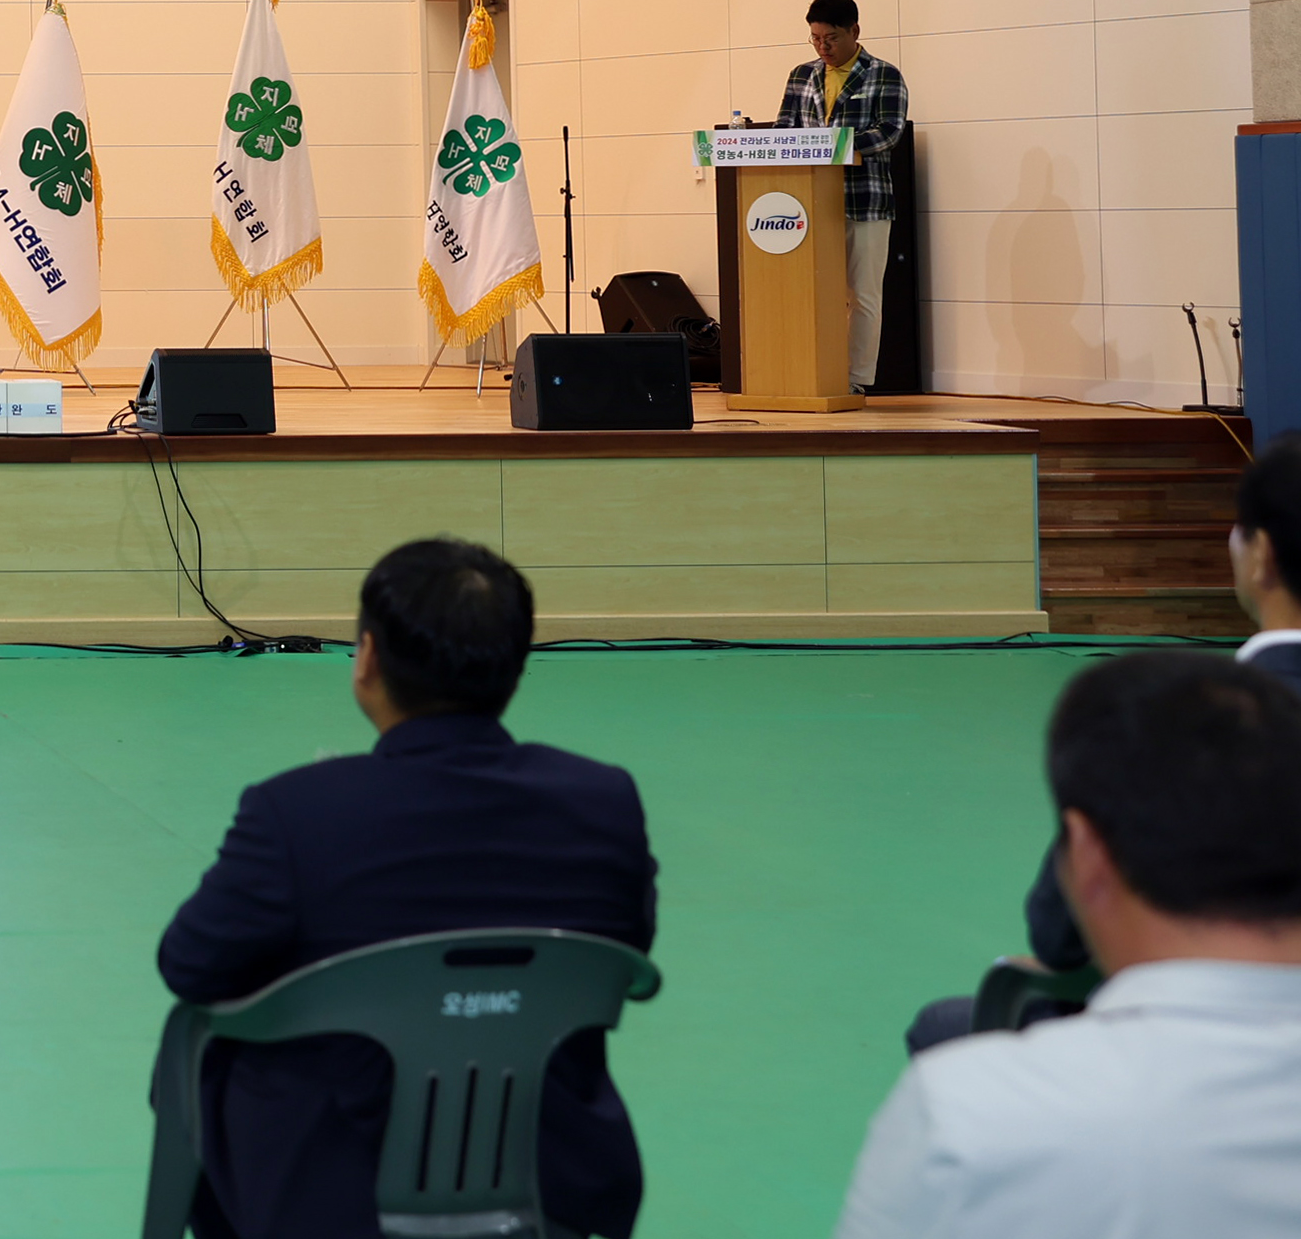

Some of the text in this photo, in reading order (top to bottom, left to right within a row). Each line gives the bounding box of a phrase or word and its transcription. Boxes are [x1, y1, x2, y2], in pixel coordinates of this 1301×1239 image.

[716, 137, 738, 146] 2024
[739, 136, 771, 146] 전라남도
[773, 136, 797, 145] 서남권
[716, 147, 833, 161] 영농4-H회원 한마음대회
[750, 217, 795, 232] Jindo
